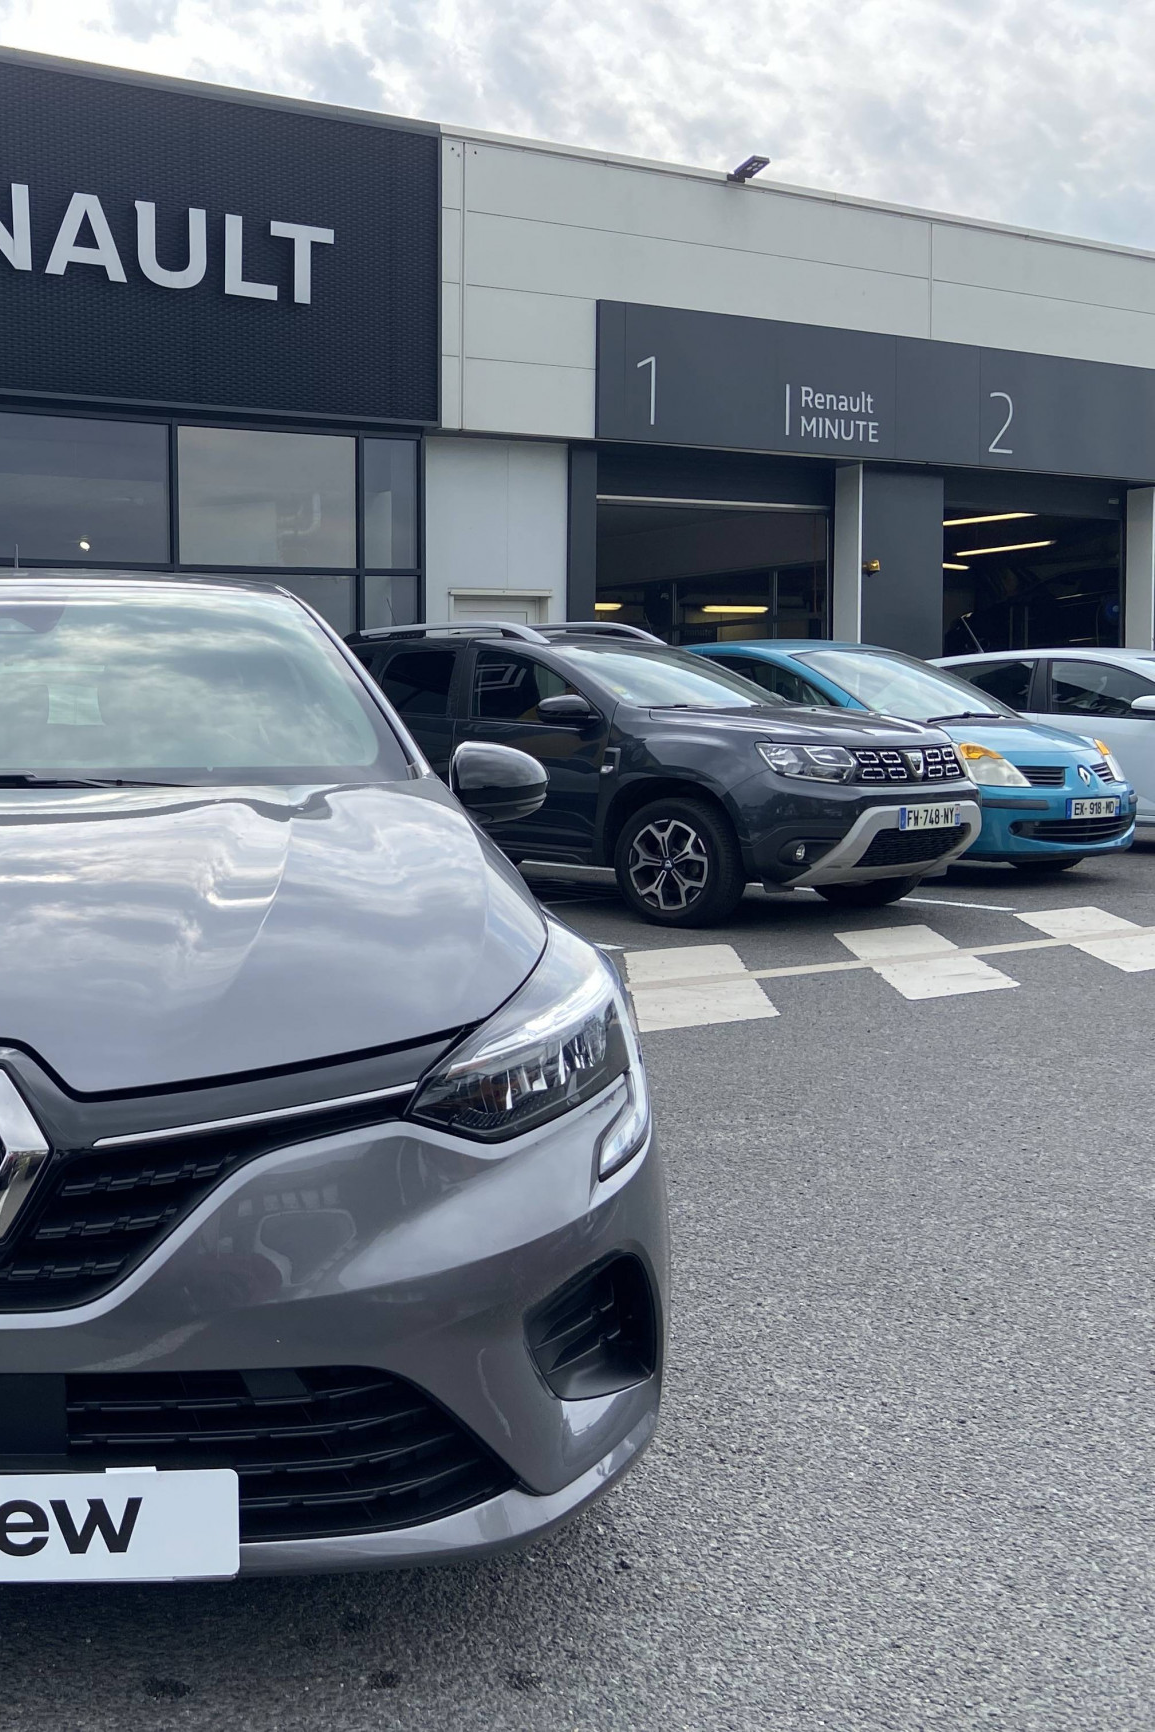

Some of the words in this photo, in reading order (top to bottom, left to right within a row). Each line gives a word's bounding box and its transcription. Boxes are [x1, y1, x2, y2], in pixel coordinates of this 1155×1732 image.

[636, 355, 657, 426] 1
[800, 385, 875, 415] Renault
[800, 415, 880, 443] MINUTE
[987, 391, 1015, 455] 2
[907, 807, 954, 828] FW-748-NY
[1073, 799, 1115, 816] EX-918-MD
